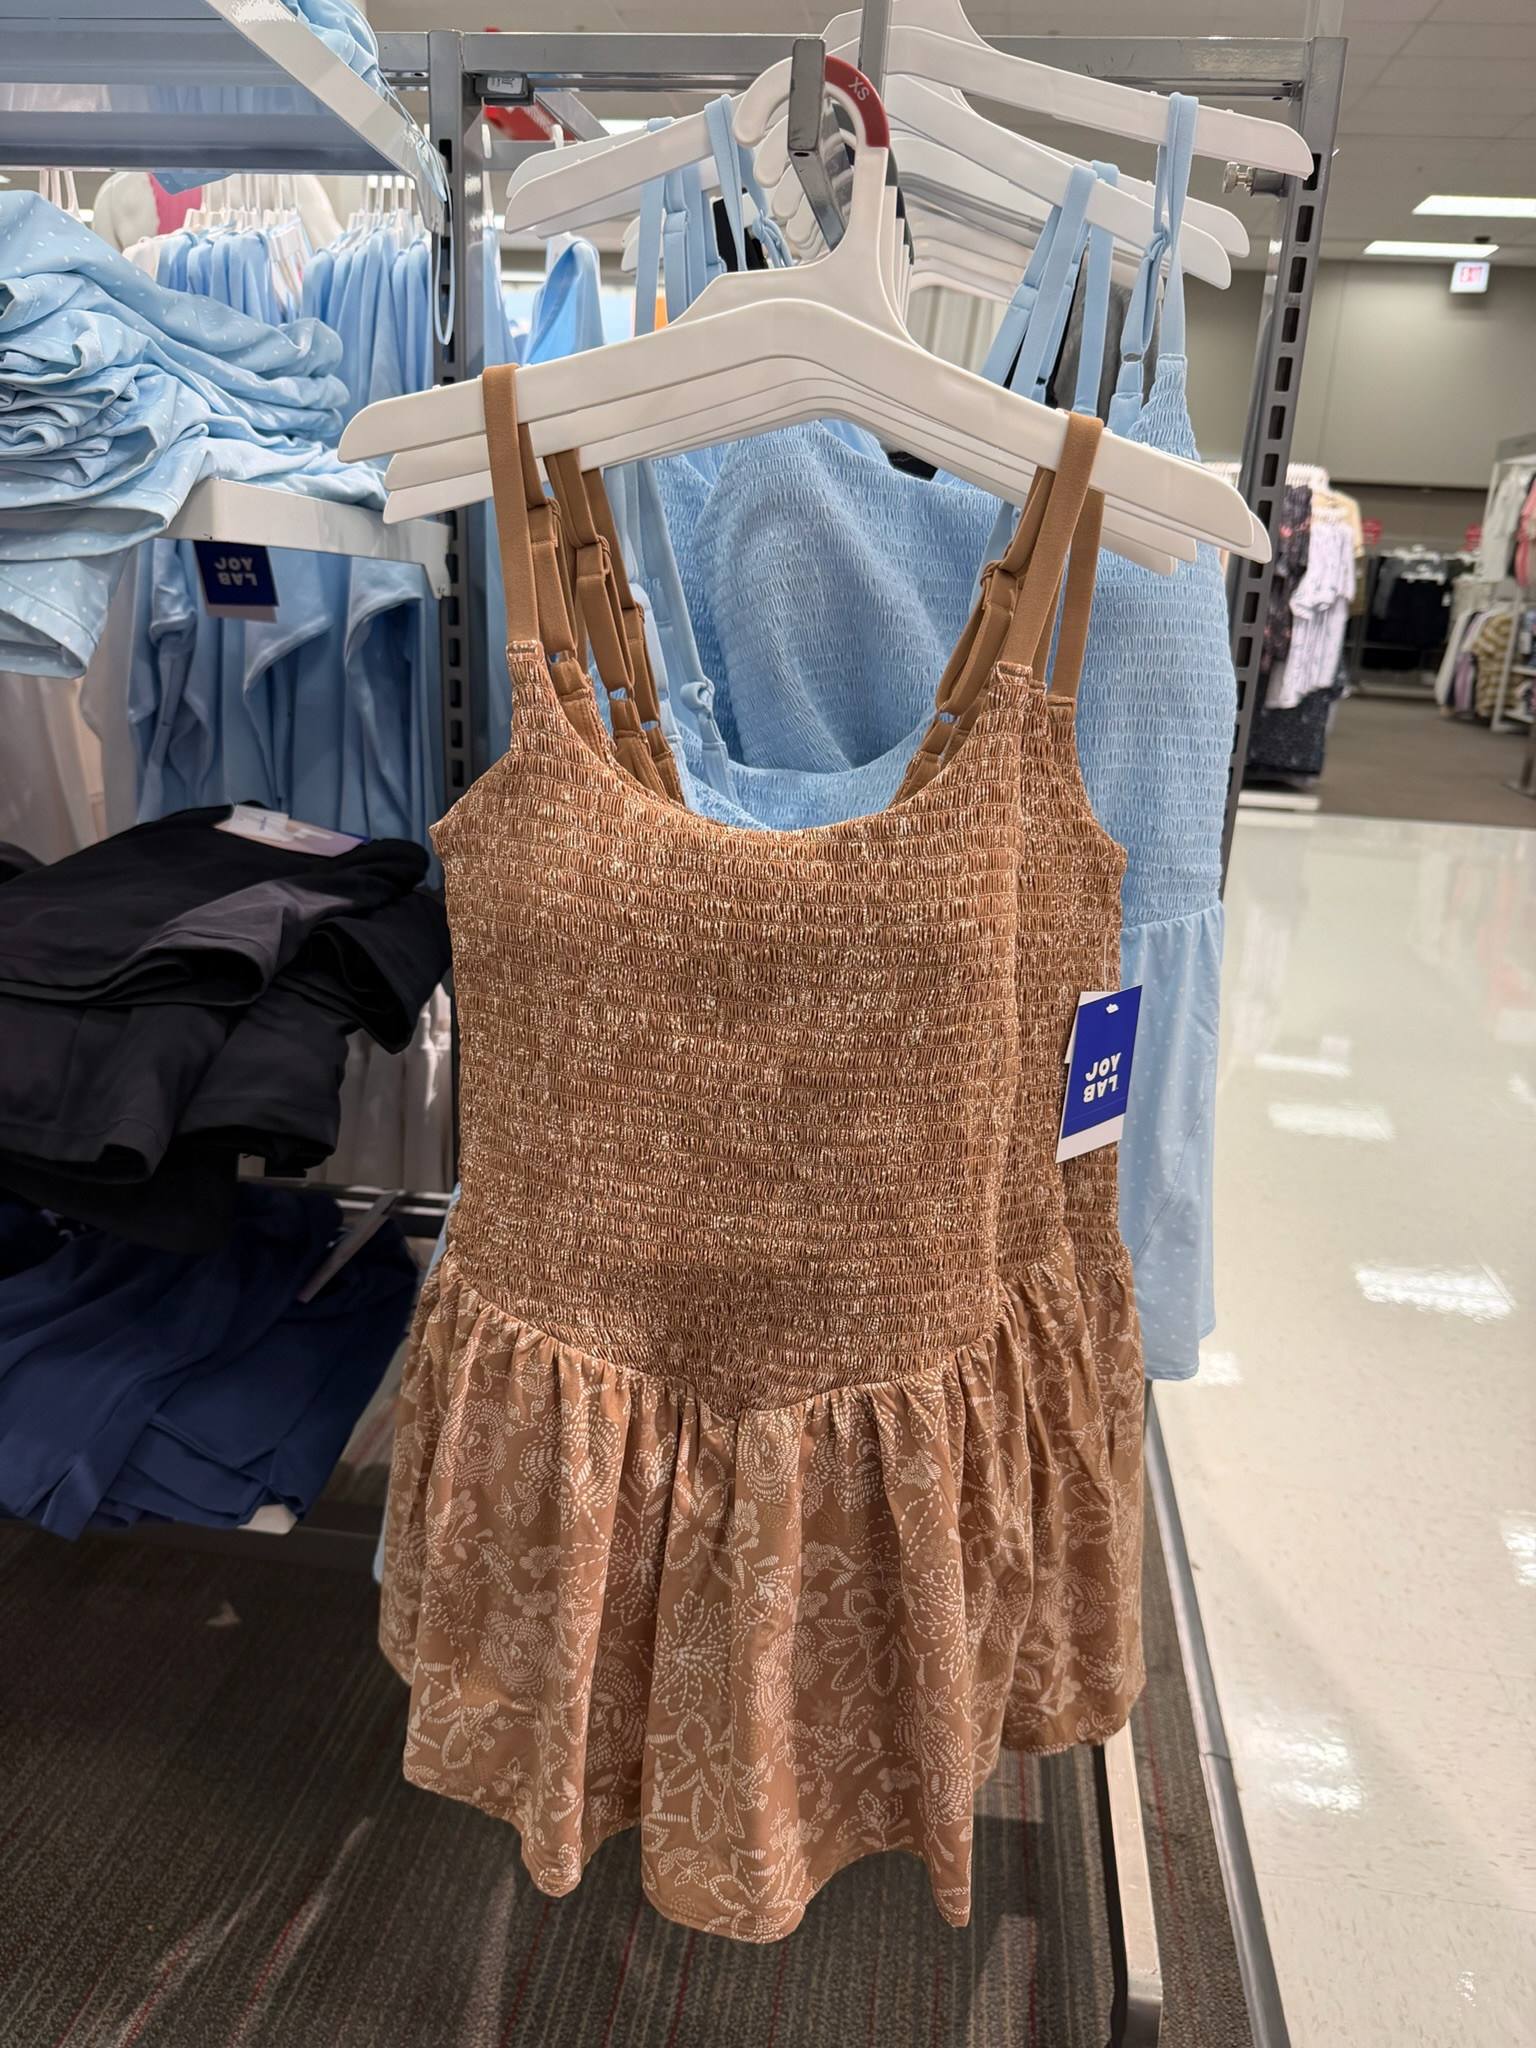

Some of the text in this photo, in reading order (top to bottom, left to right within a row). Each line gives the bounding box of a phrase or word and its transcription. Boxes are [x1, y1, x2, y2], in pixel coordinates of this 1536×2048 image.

[848, 77, 870, 101] XS
[214, 556, 253, 571] JOY
[218, 572, 258, 587] LAB
[1085, 1052, 1122, 1082] JOY
[1083, 1074, 1119, 1104] LAB
